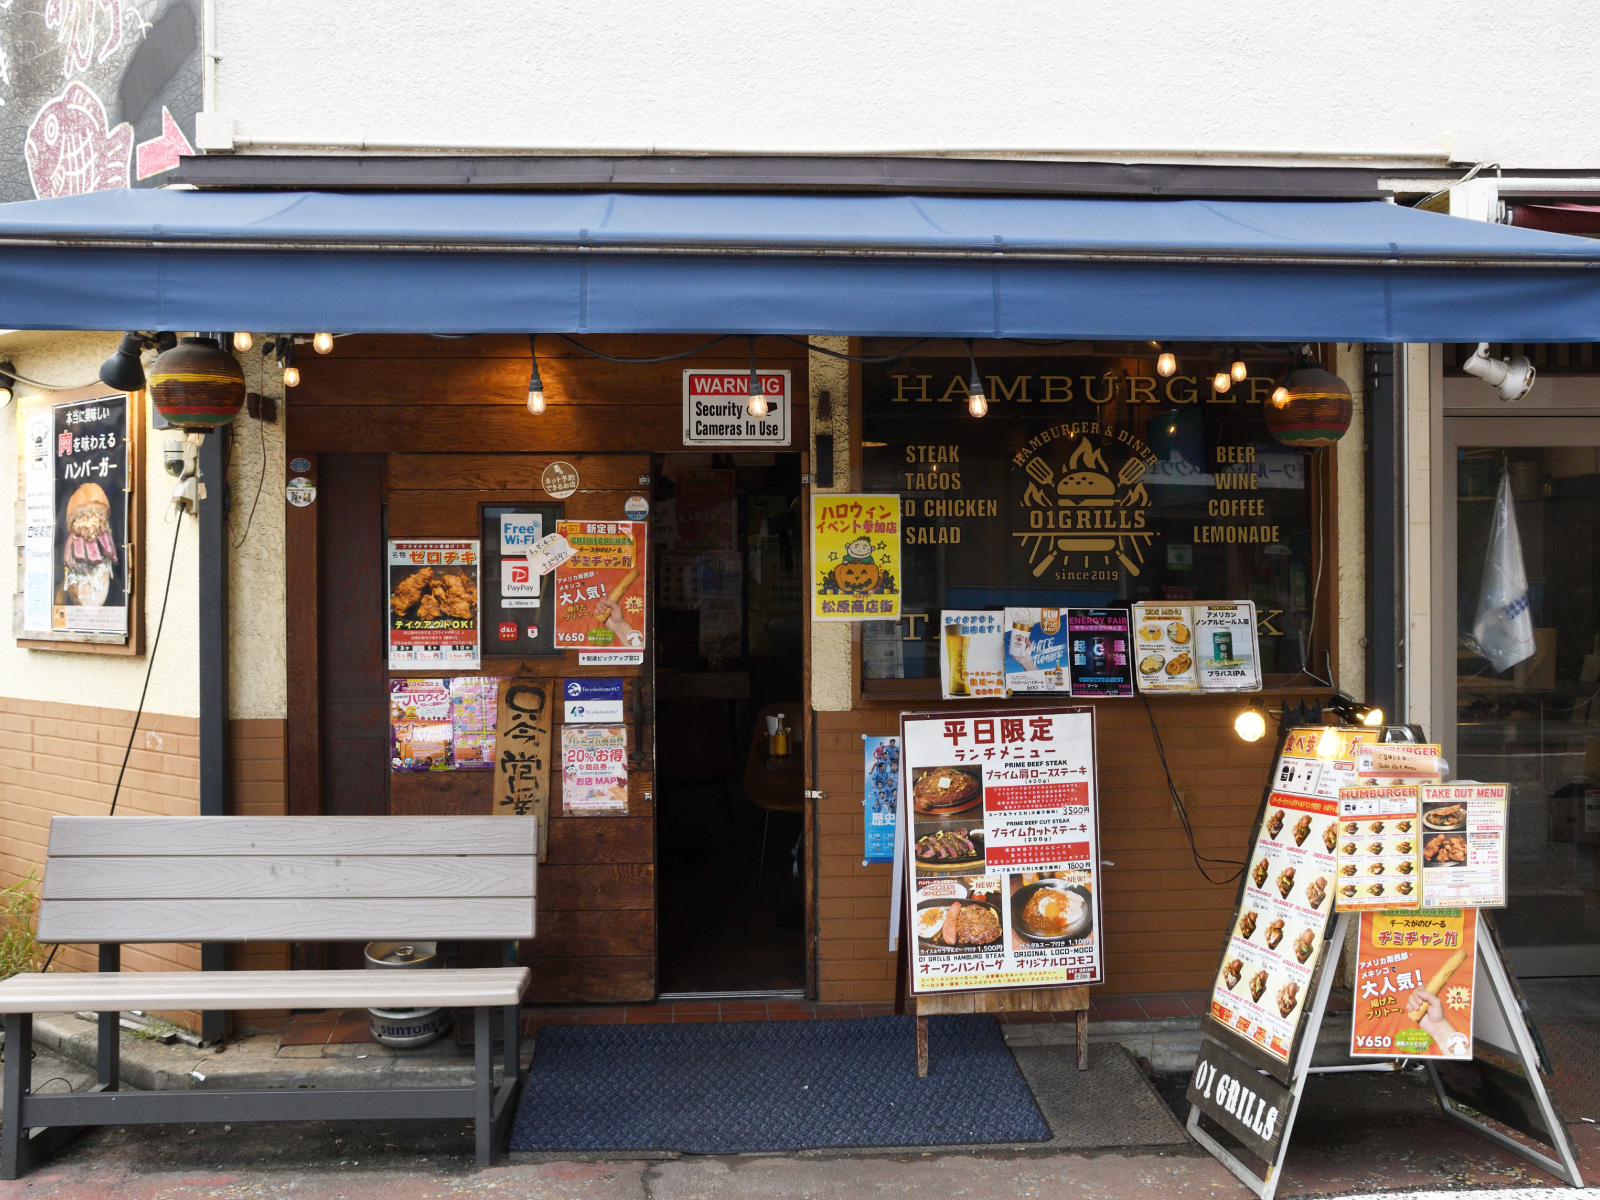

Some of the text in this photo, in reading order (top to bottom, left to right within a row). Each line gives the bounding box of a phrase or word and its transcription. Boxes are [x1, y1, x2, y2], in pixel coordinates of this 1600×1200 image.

[694, 378, 780, 394] WARNG
[66, 407, 110, 425] 本当に美味しい
[696, 401, 742, 420] Security
[696, 420, 779, 436] Cameras In Use
[58, 430, 116, 458] 肉を味わえる
[1013, 422, 1158, 467] HAMBURGER & DINER
[906, 445, 960, 463] STEAK
[1217, 446, 1256, 463] BEER
[64, 457, 118, 482] ハンバーガー
[905, 472, 962, 490] TACOS
[1215, 473, 1259, 490] WINE
[820, 502, 892, 521] ハロウィン
[924, 499, 998, 517] CHICKEN
[1209, 499, 1265, 517] COFFEE
[816, 520, 898, 534] イベント参加店
[1030, 510, 1146, 529] 01GRILLS
[504, 523, 535, 534] Free
[586, 523, 622, 535] 新定番!
[906, 527, 961, 544] SALAD
[1193, 526, 1280, 543] LEMONADE
[505, 535, 535, 545] Wi-Fi
[409, 550, 477, 566] ゼロチキ
[571, 555, 633, 568] チミチャンガ
[1055, 568, 1118, 581] since 2019
[507, 584, 534, 595] PayPay
[560, 583, 607, 606] 大人気!
[821, 600, 893, 614] 松原商店街
[1042, 610, 1059, 619] NEW
[1069, 616, 1128, 625] ENERGY FAIR
[557, 632, 585, 643] ¥650
[587, 654, 641, 664] 配達ピックアップ窓口
[943, 716, 1054, 746] 平日限定
[955, 747, 1056, 762] ランチメニュー
[1045, 760, 1068, 768] STEAK
[595, 777, 617, 785] MAP
[986, 766, 1087, 781] プライム肩ロースステーキ
[1341, 787, 1416, 801] HUMBURGER
[1425, 788, 1504, 800] TAKE OUT MENU
[1062, 805, 1090, 815] 3500円
[991, 823, 1087, 838] プライムカットステーキ
[1067, 861, 1091, 870] 1800円
[975, 881, 995, 889] NEW!
[1067, 875, 1087, 884] NEW!
[1377, 929, 1458, 946] チミチャンガ
[985, 952, 1006, 960] STEAK
[1013, 946, 1094, 959] ORIGINAL LOCO-MOCO
[919, 959, 1005, 975] オーワンハンバーグ
[1016, 955, 1094, 969] オリジナルロコモコ
[1360, 968, 1424, 999] 大人気!
[1370, 995, 1398, 1009] 揚げた
[1355, 1034, 1392, 1049] ¥650
[1215, 1073, 1279, 1141] GRILLS
